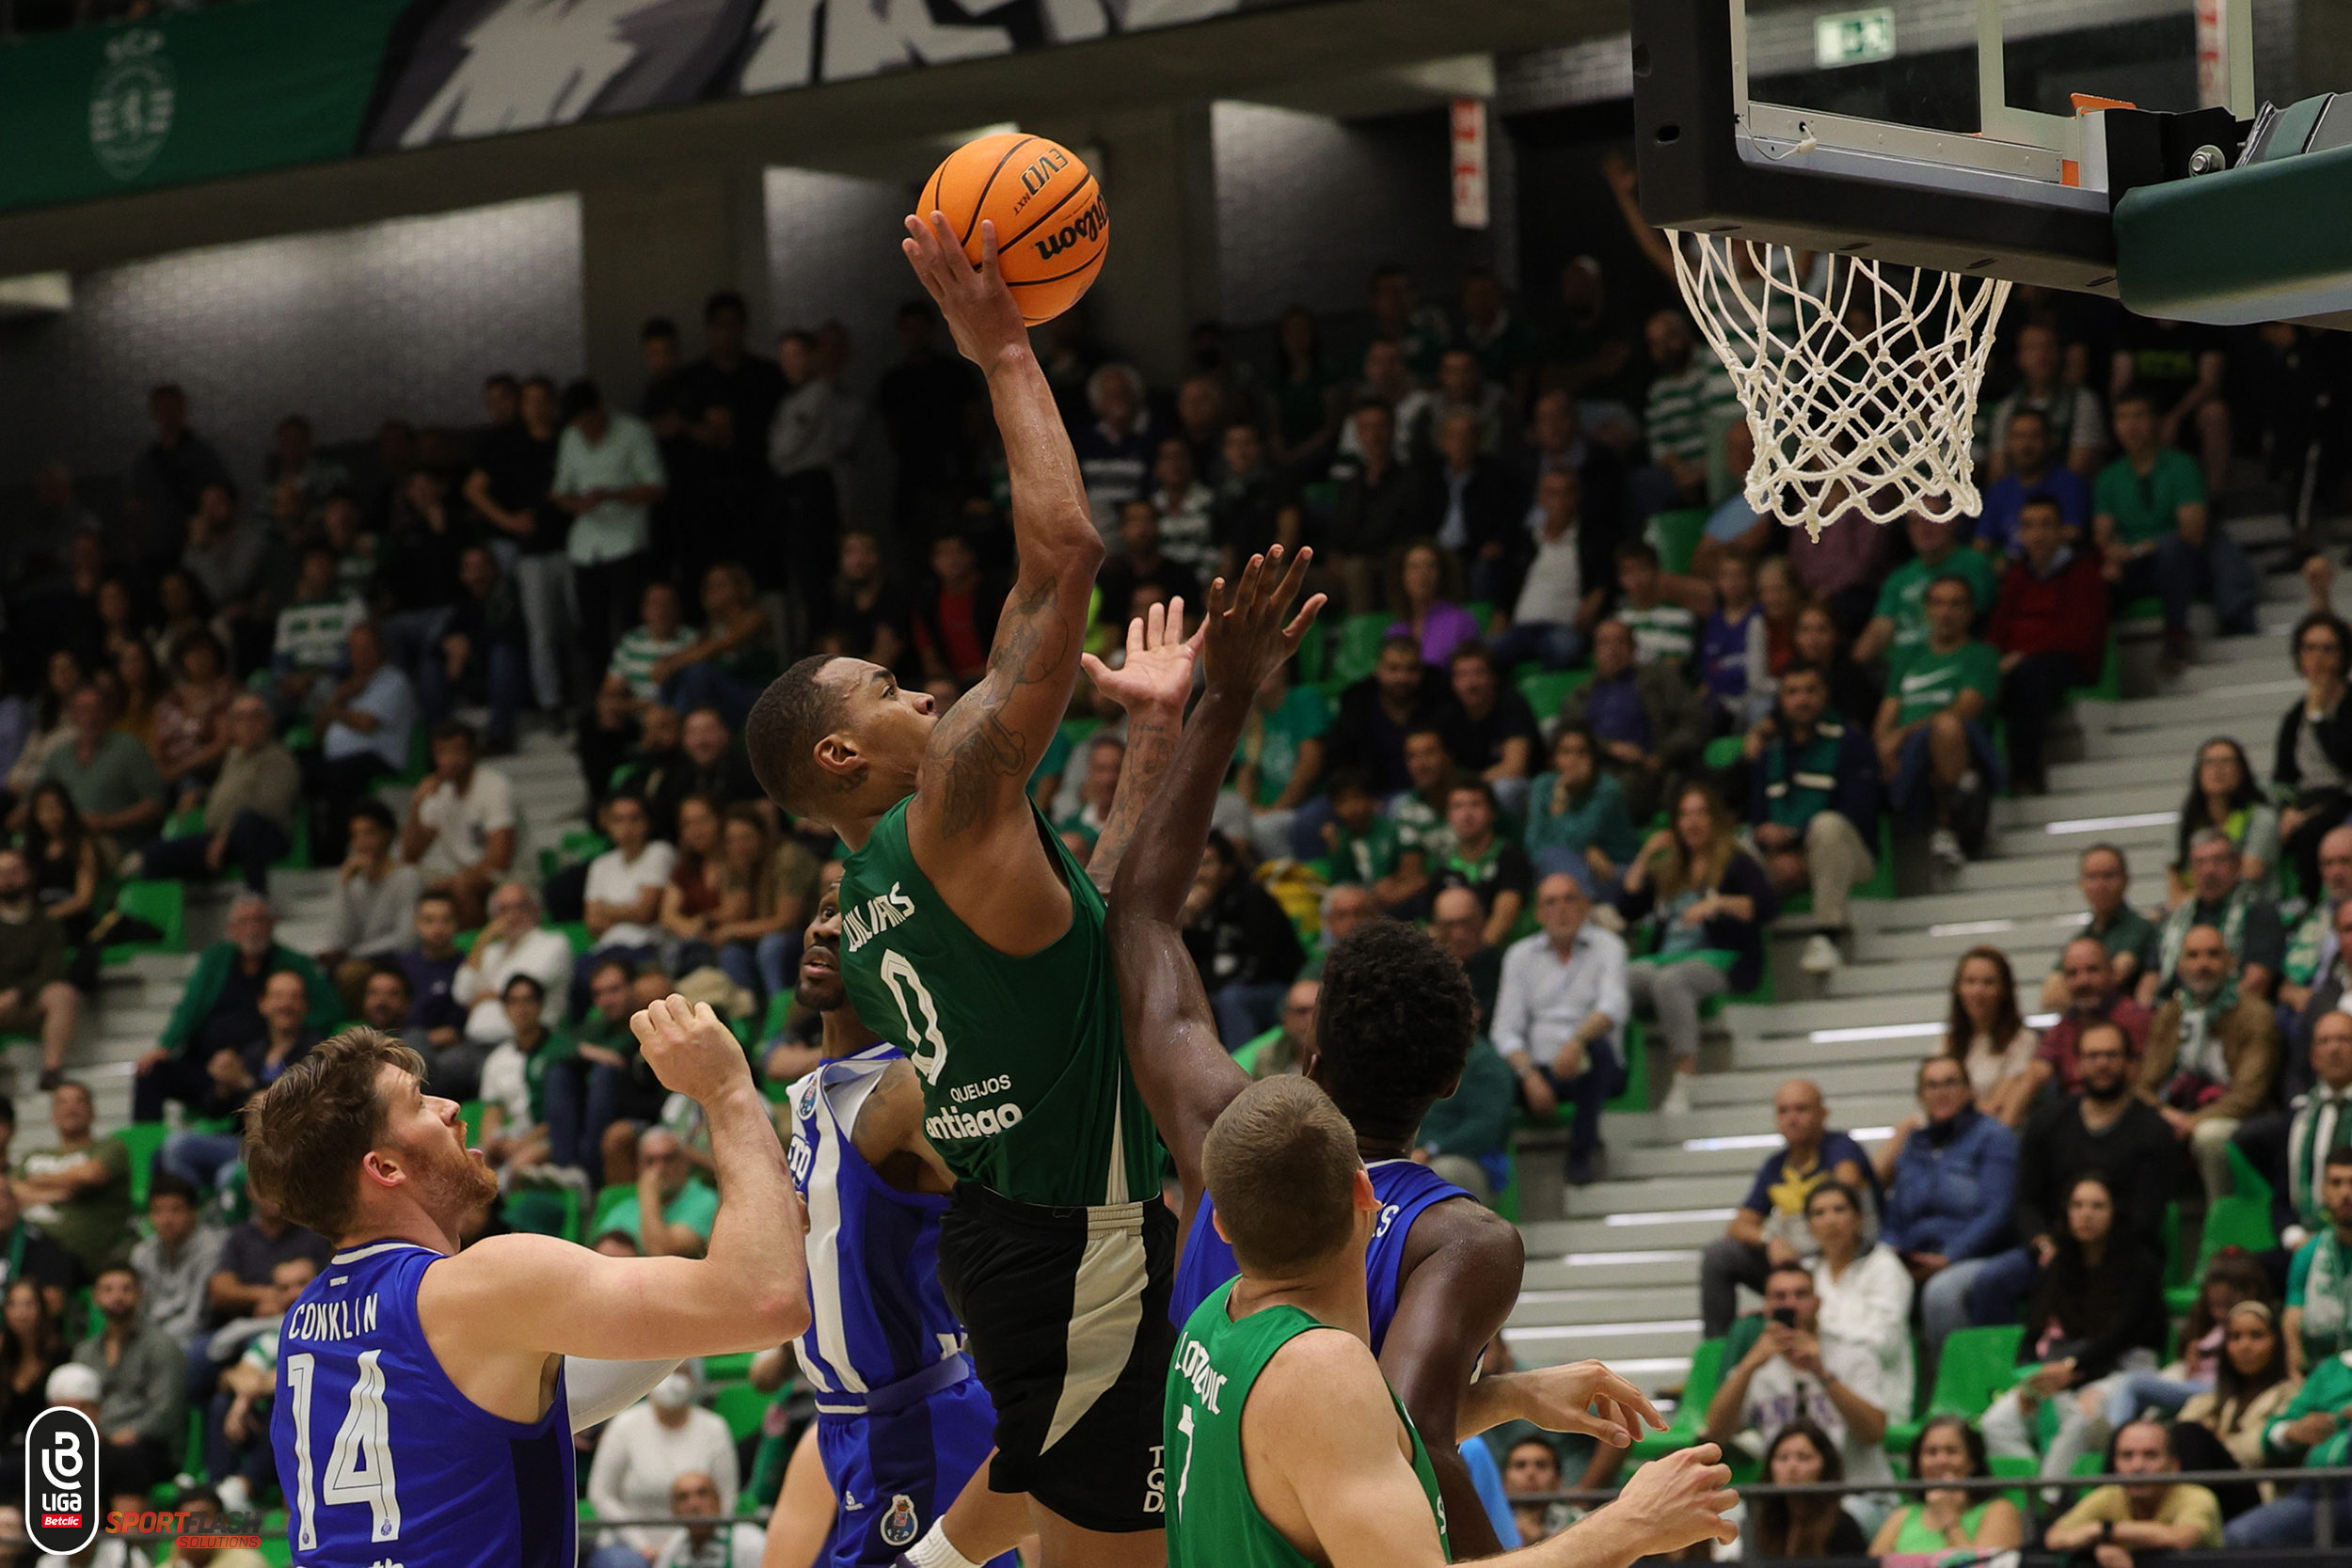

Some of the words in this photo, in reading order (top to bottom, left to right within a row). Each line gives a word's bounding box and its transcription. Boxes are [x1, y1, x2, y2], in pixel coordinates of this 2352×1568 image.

[1020, 148, 1069, 197] EVO
[1013, 193, 1031, 215] NXT
[881, 948, 947, 1086] 0
[950, 1074, 1012, 1103] QUEIJOS
[288, 1292, 377, 1341] CONKLIN
[287, 1349, 401, 1551] 14
